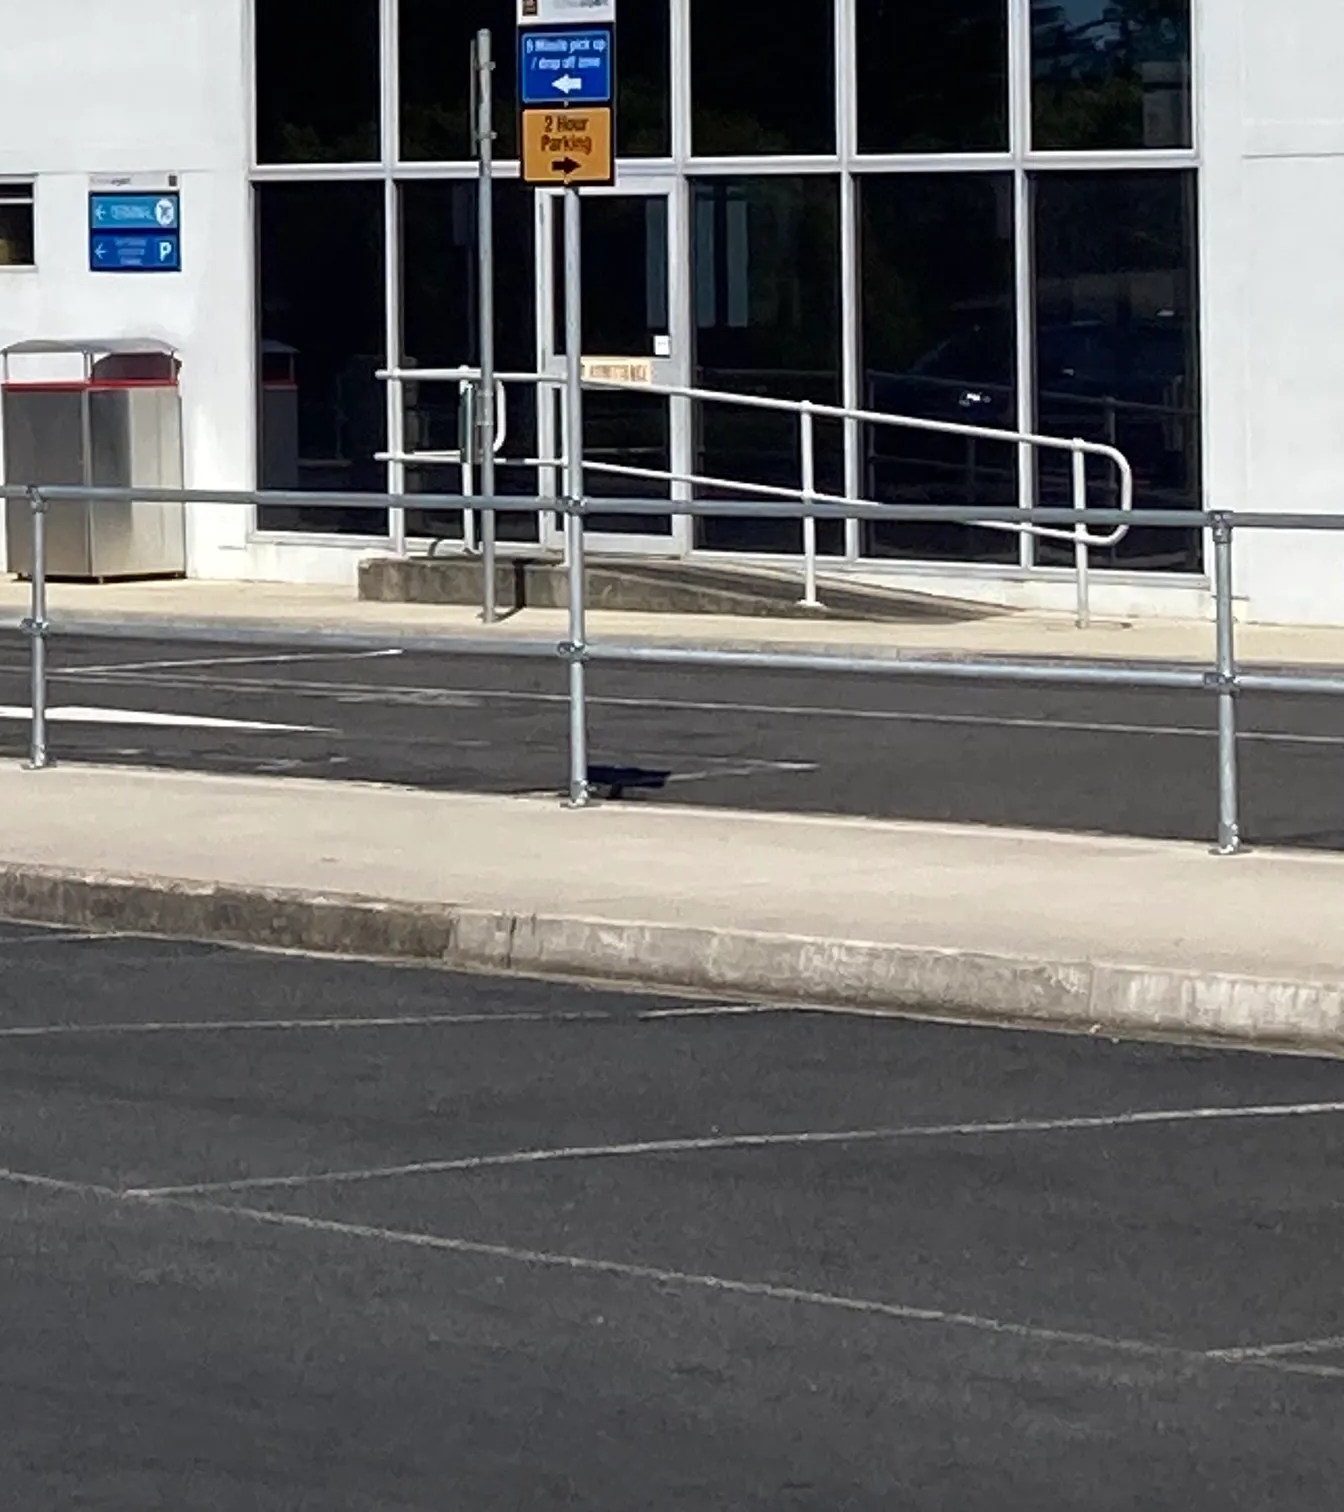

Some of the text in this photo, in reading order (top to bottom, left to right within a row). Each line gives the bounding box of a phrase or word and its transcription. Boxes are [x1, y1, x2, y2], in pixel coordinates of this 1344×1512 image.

[569, 38, 590, 54] pick
[544, 115, 590, 133] 2 Hour
[540, 134, 593, 155] Parking
[159, 241, 172, 262] P
